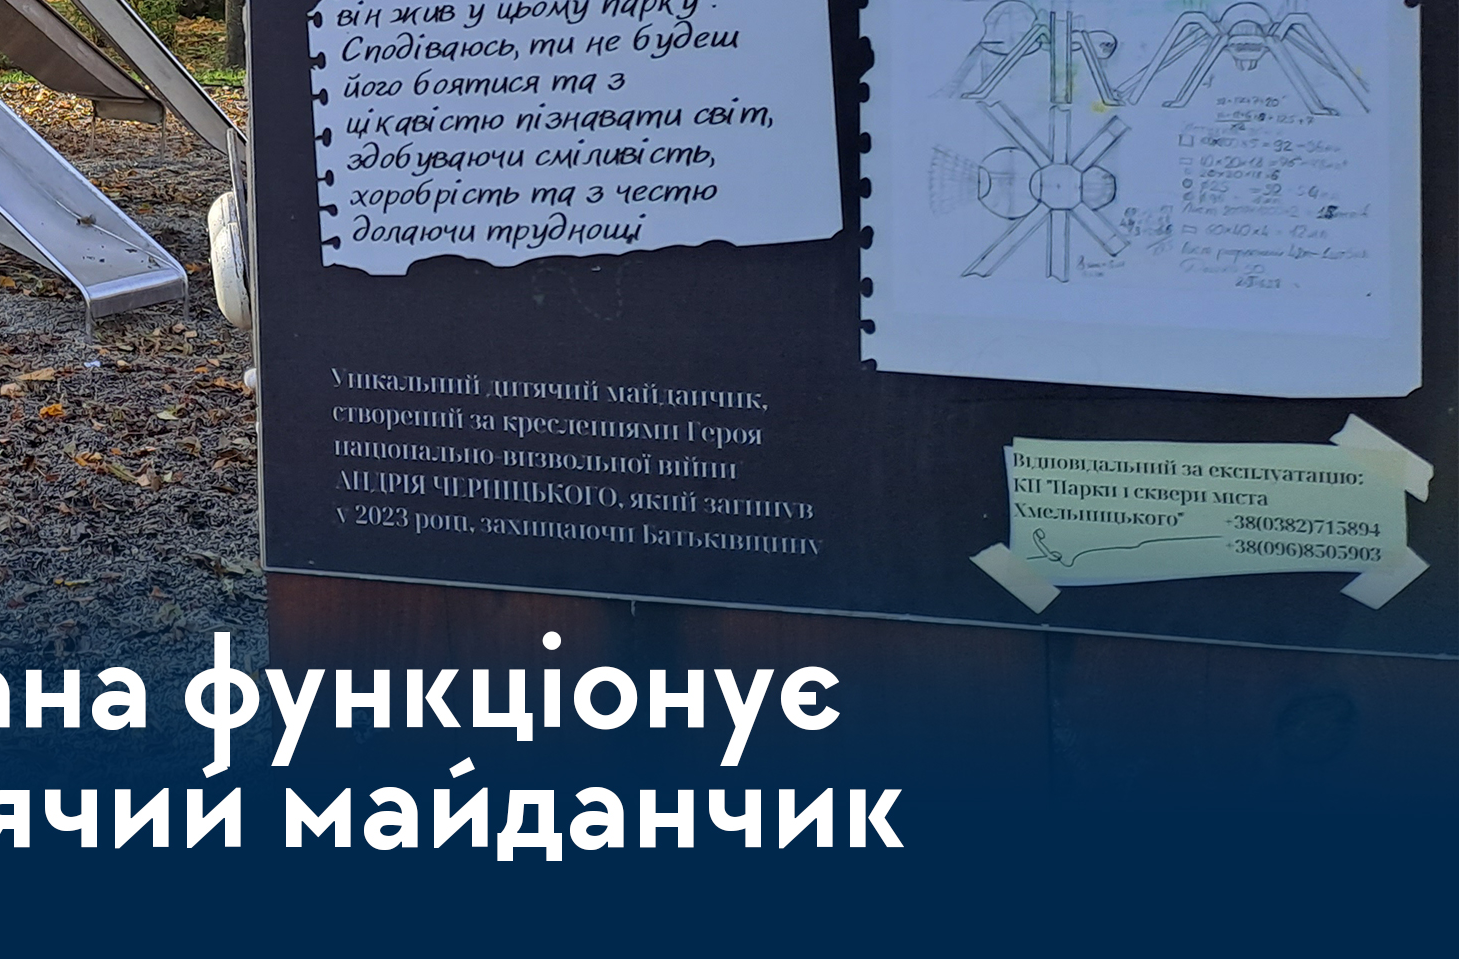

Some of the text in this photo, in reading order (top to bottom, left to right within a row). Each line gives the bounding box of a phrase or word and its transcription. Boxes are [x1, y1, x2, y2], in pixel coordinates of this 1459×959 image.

[336, 1, 381, 28] він
[390, 5, 455, 24] жив
[464, 2, 485, 27] у
[341, 22, 740, 63] Сподіваюсь, ти не будеш
[343, 70, 626, 100] його боятися та з
[346, 97, 773, 138] цікавістю пізнавати світ,
[347, 138, 716, 173] здобуваючи сміливість,
[350, 179, 718, 215] хоробрість та з честю
[352, 212, 647, 249] долаючи труднощі
